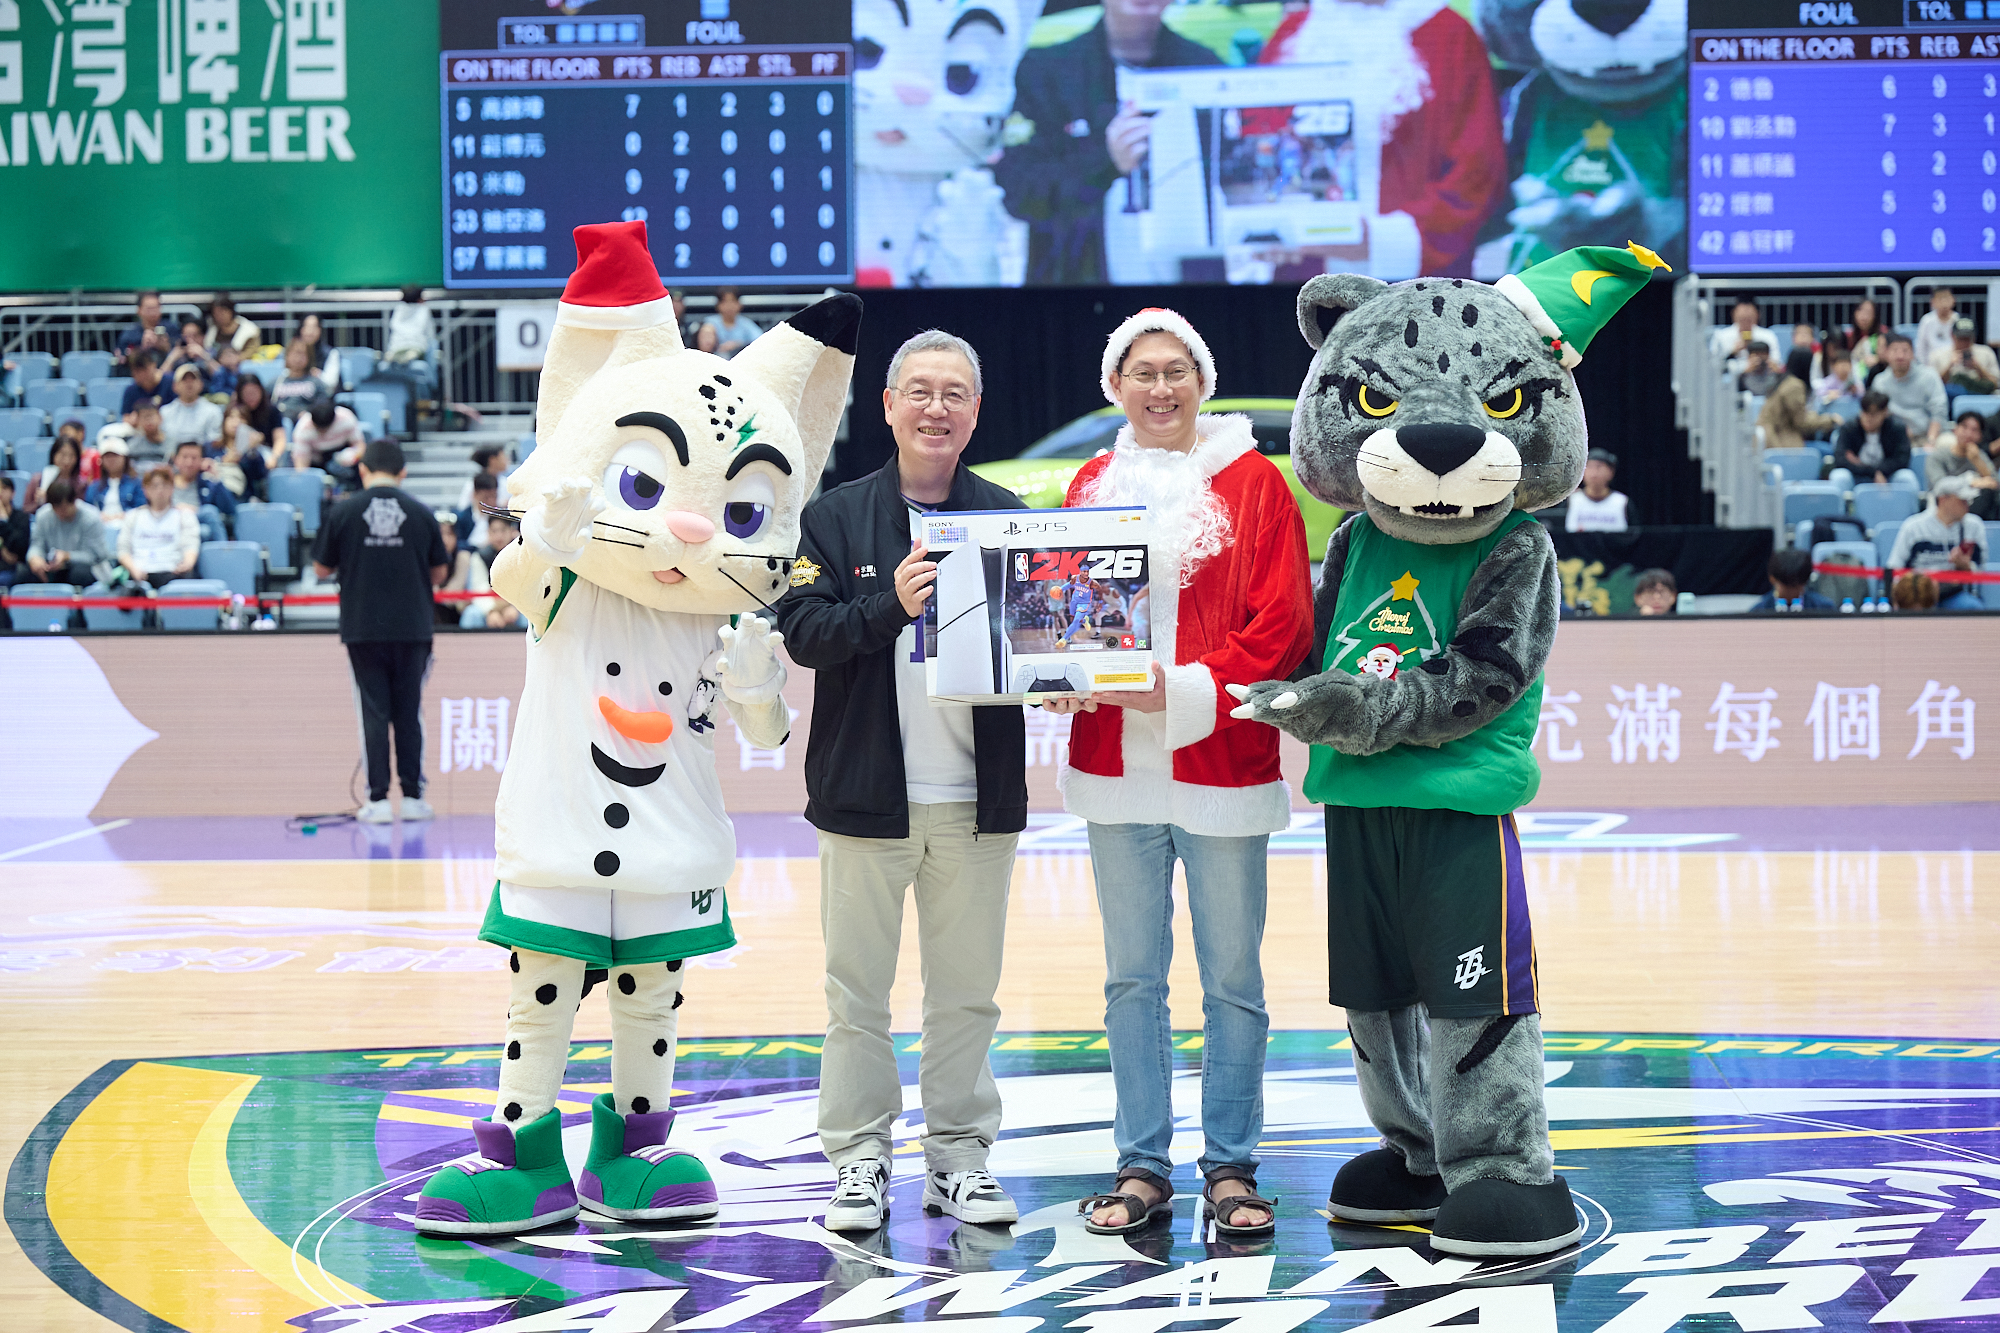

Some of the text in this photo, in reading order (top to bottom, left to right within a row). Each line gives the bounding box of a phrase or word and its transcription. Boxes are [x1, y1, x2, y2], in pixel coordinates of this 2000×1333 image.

[1800, 2, 1859, 25] FOUL
[1917, 1, 1955, 20] TOL
[686, 21, 745, 44] FOUL
[0, 0, 347, 107] 灣啤酒
[1702, 38, 1739, 61] ON
[1740, 38, 1782, 60] THE
[1784, 37, 1855, 60] FLOOR
[1870, 36, 1910, 58] PTS
[1920, 36, 1960, 57] REB
[454, 53, 839, 81] ON THE FLOOR PTS REB AST STL PF
[1703, 77, 1719, 101] 2
[1983, 73, 1997, 97] 3
[625, 94, 641, 118] 7
[673, 93, 688, 118] 1
[721, 92, 737, 117] 2
[769, 91, 785, 116] 3
[0, 106, 356, 166] IWAN BEER
[1699, 115, 1725, 140] 10
[1882, 112, 1897, 137] 7
[1932, 112, 1947, 137] 3
[1984, 112, 1995, 136] 1
[452, 134, 475, 158] 11
[673, 130, 690, 155] 2
[818, 128, 833, 153] 1
[1699, 153, 1723, 178] 11
[1931, 150, 1947, 175] 2
[1982, 150, 1997, 175] 0
[452, 171, 478, 196] 13
[674, 168, 690, 193] 7
[722, 167, 737, 192] 1
[770, 167, 785, 192] 1
[819, 166, 833, 191] 1
[1698, 191, 1725, 217] 22
[1931, 189, 1947, 214] 3
[1982, 188, 1997, 213] 0
[452, 209, 479, 234] 33
[770, 204, 785, 229] 1
[1931, 227, 1947, 252] 0
[1982, 227, 1997, 251] 2
[1026, 522, 1068, 532] PS5
[1368, 616, 1414, 635] Christmas
[1378, 606, 1410, 626] Merry
